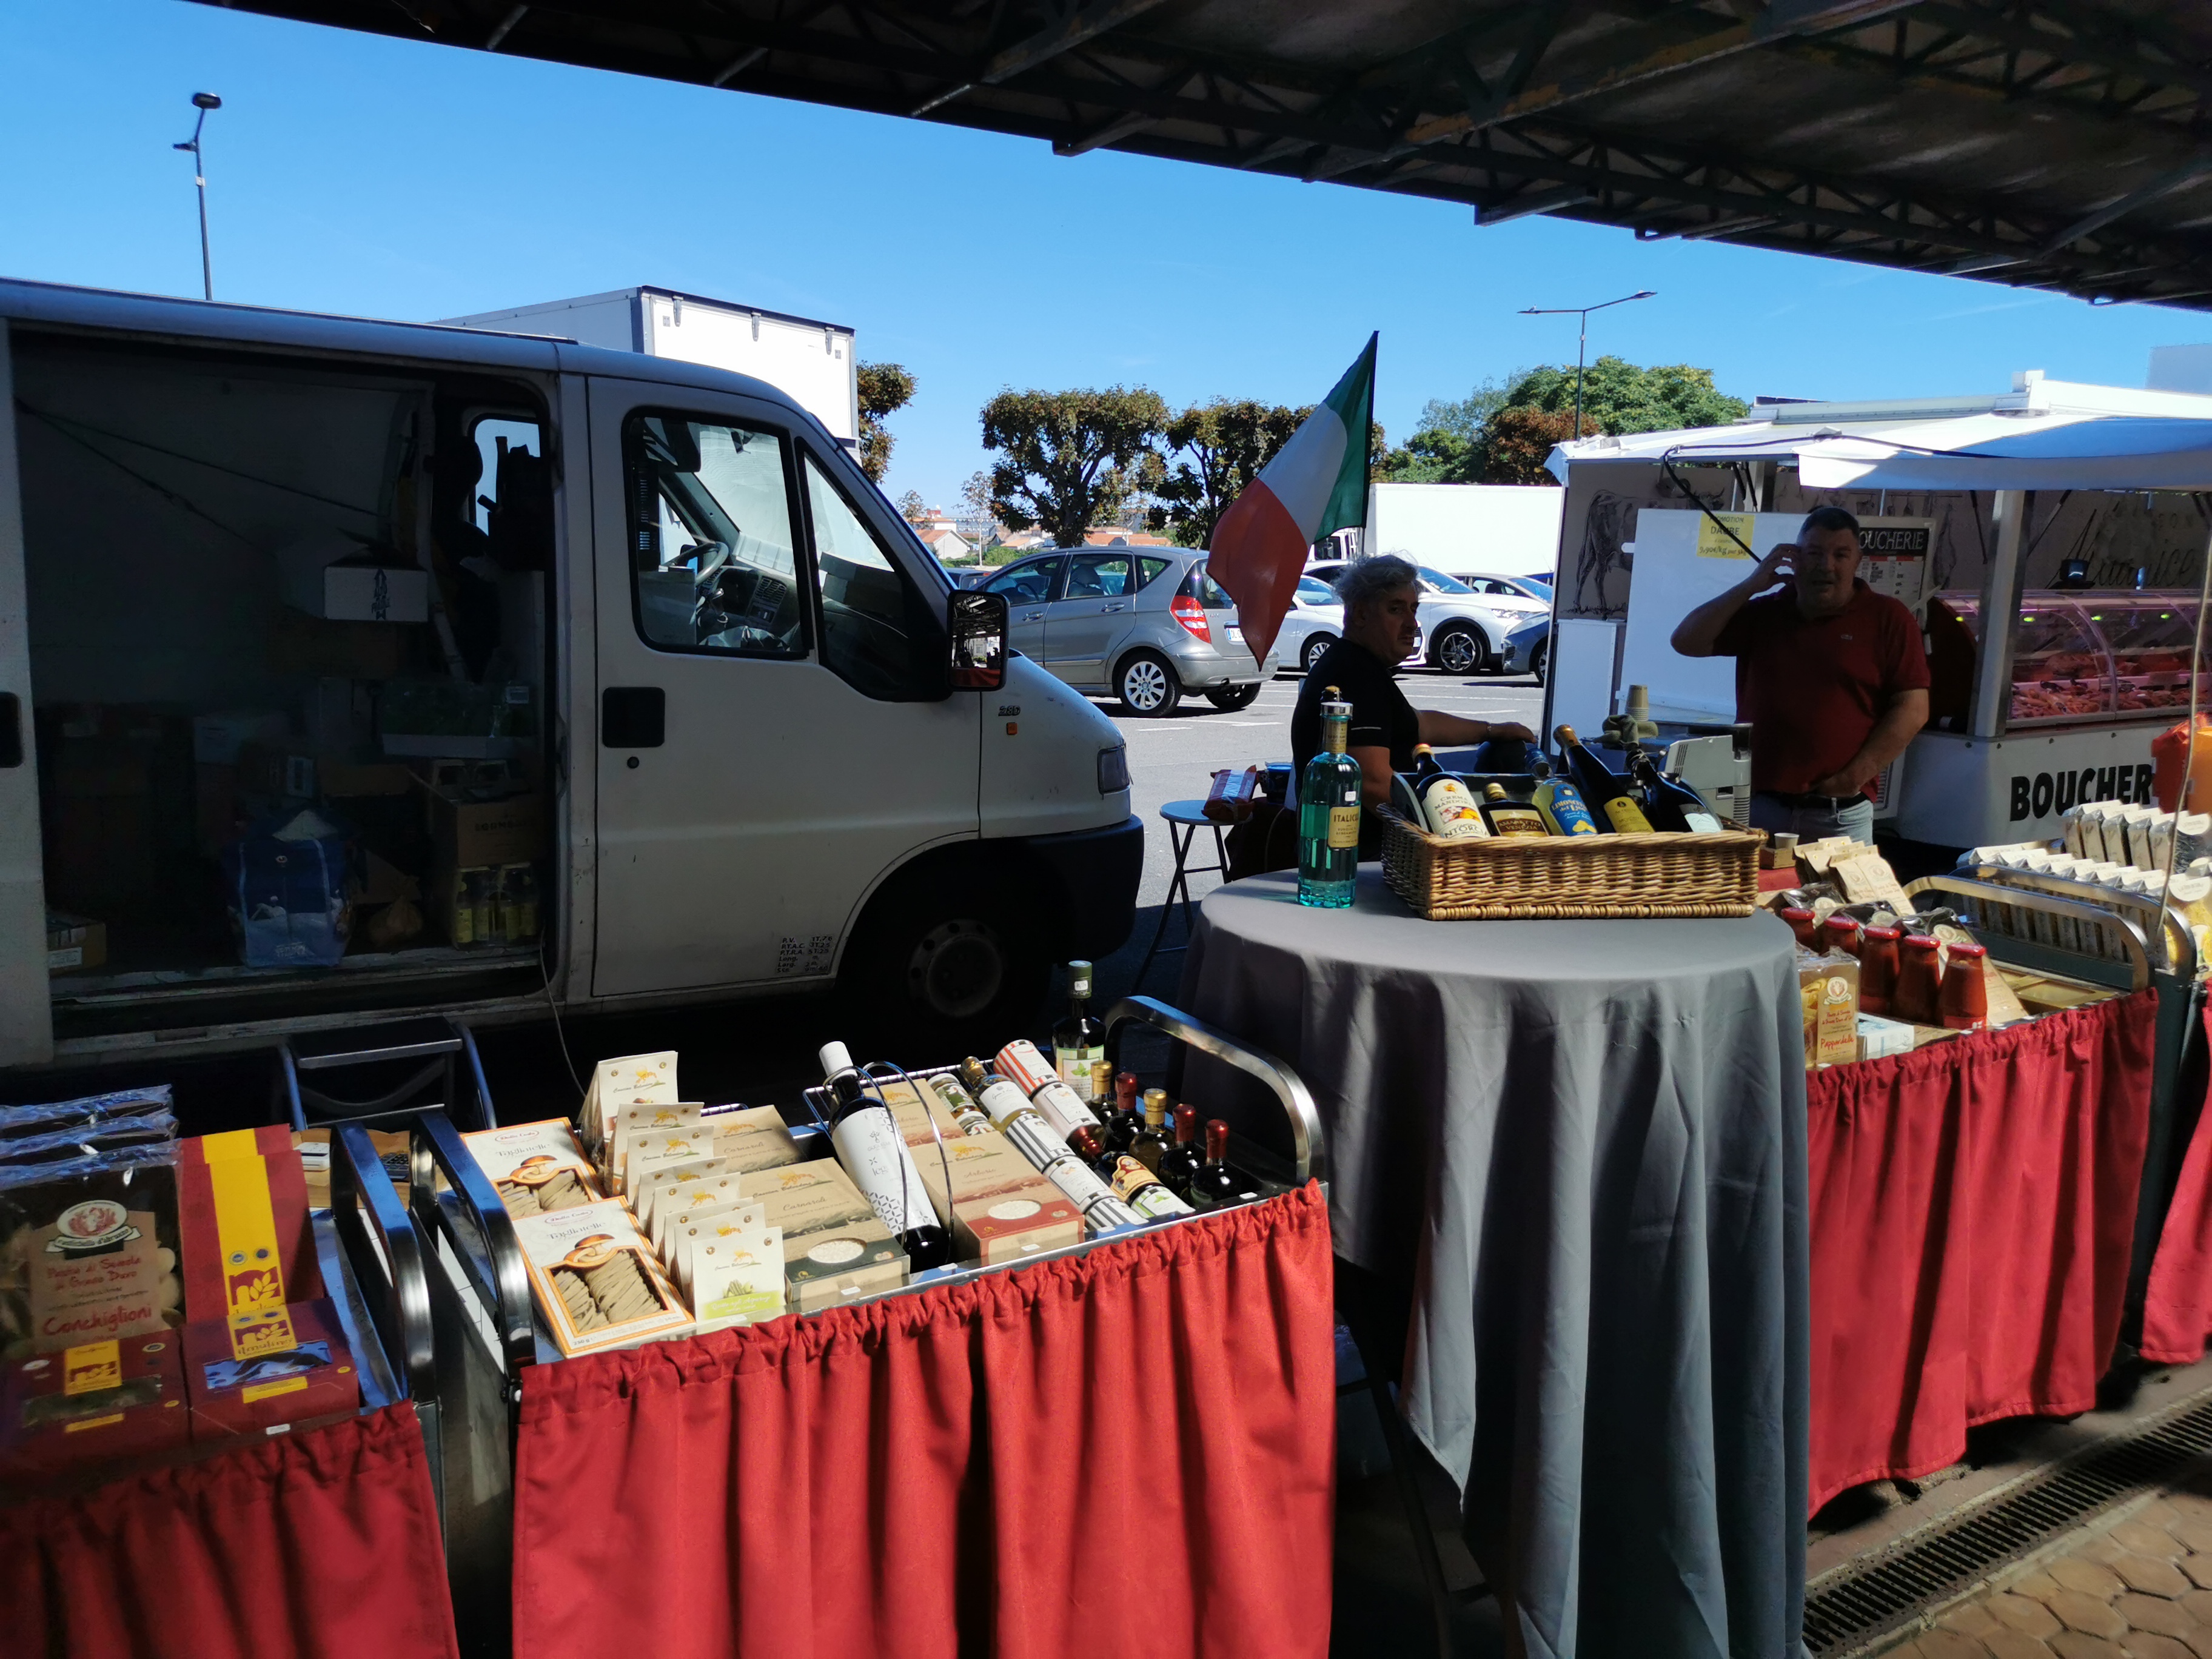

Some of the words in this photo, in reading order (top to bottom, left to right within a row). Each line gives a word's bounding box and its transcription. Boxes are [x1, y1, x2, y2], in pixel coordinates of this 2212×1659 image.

[783, 1196, 828, 1212] Carnaroli
[548, 1222, 606, 1239] Tagliatelle
[44, 1305, 152, 1336] Conchiglioni
